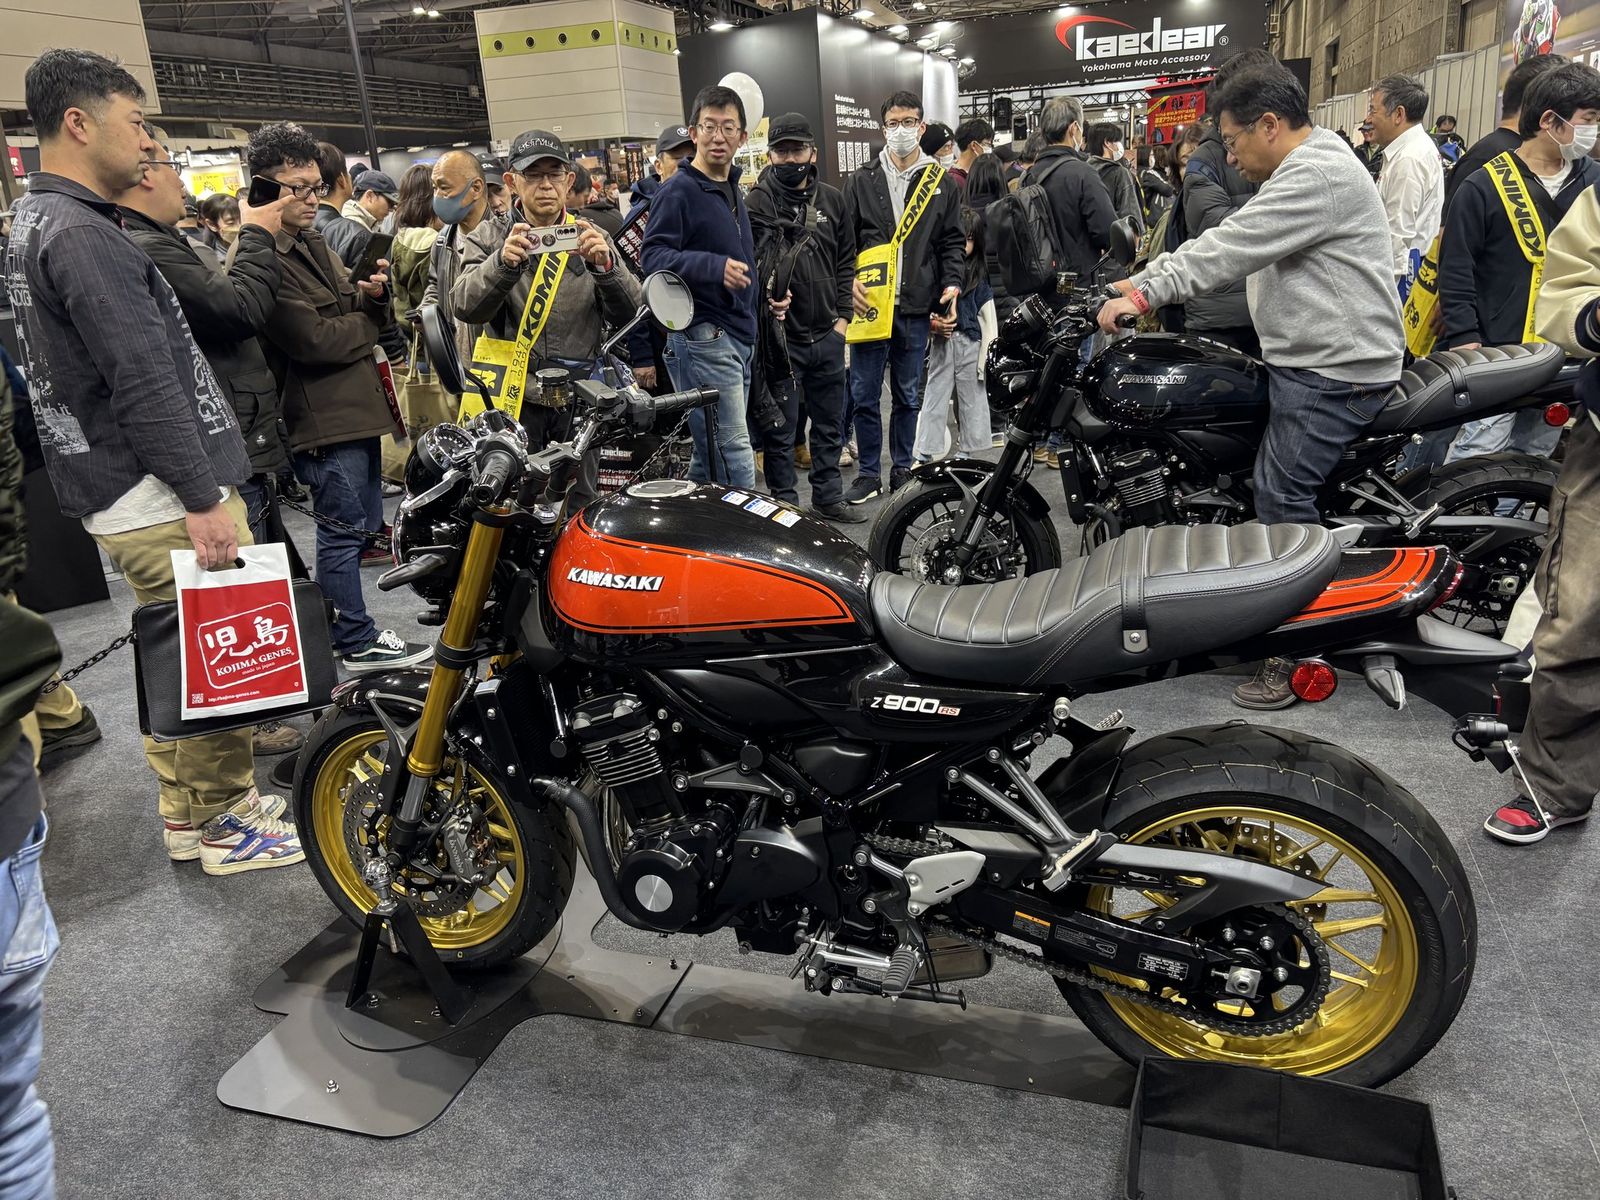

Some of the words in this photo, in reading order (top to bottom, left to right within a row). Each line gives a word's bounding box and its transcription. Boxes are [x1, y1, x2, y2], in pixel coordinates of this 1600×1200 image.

[1081, 61, 1132, 73] Yokohama
[1134, 57, 1158, 68] Moto
[1160, 53, 1211, 65] Accessory
[896, 163, 942, 244] KOMINE
[1489, 155, 1545, 257] KOMINE
[566, 566, 665, 592] KAWASAKI
[205, 615, 289, 666] 児島
[215, 658, 258, 677] KOJIMA
[258, 647, 293, 663] GENES
[241, 667, 255, 676] made
